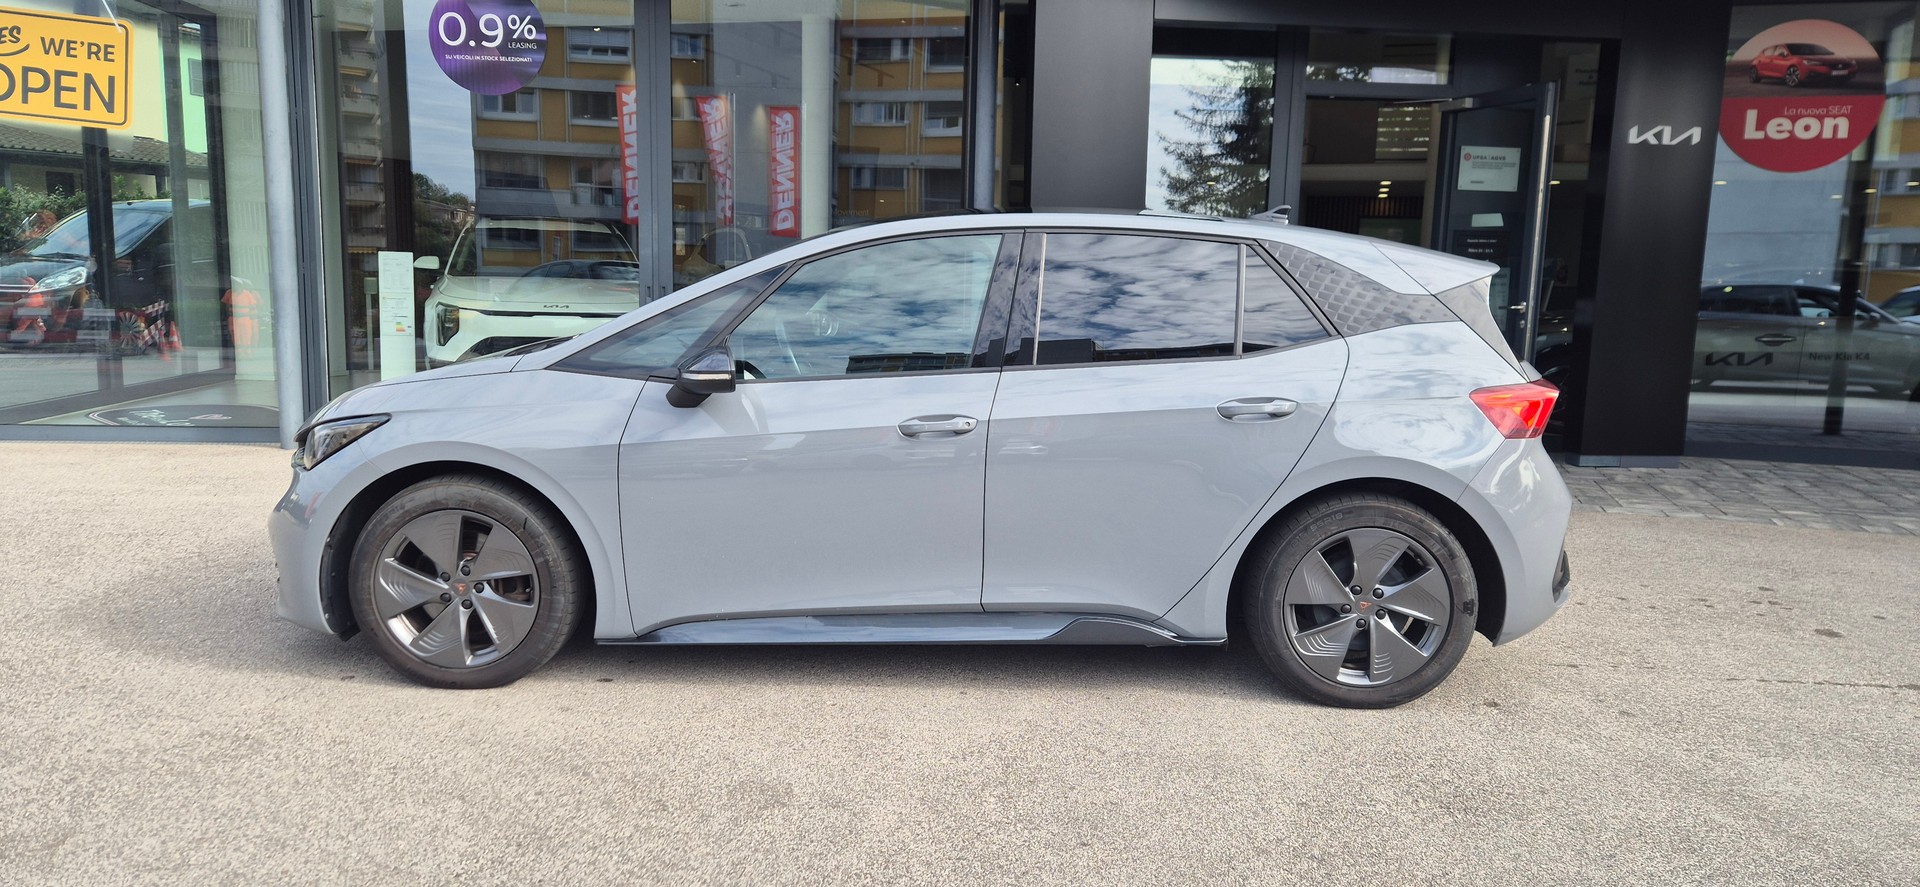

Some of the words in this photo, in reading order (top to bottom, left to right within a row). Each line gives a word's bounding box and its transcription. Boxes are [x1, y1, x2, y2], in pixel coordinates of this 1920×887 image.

[0, 25, 21, 45] ES
[1784, 106, 1796, 115] La
[1797, 107, 1828, 115] nuova
[1828, 105, 1853, 115] SEAT
[1744, 109, 1850, 140] Leon
[1627, 125, 1702, 145] KIA
[1809, 352, 1832, 361] New
[1835, 352, 1852, 361] Kia
[1855, 352, 1870, 361] K4
